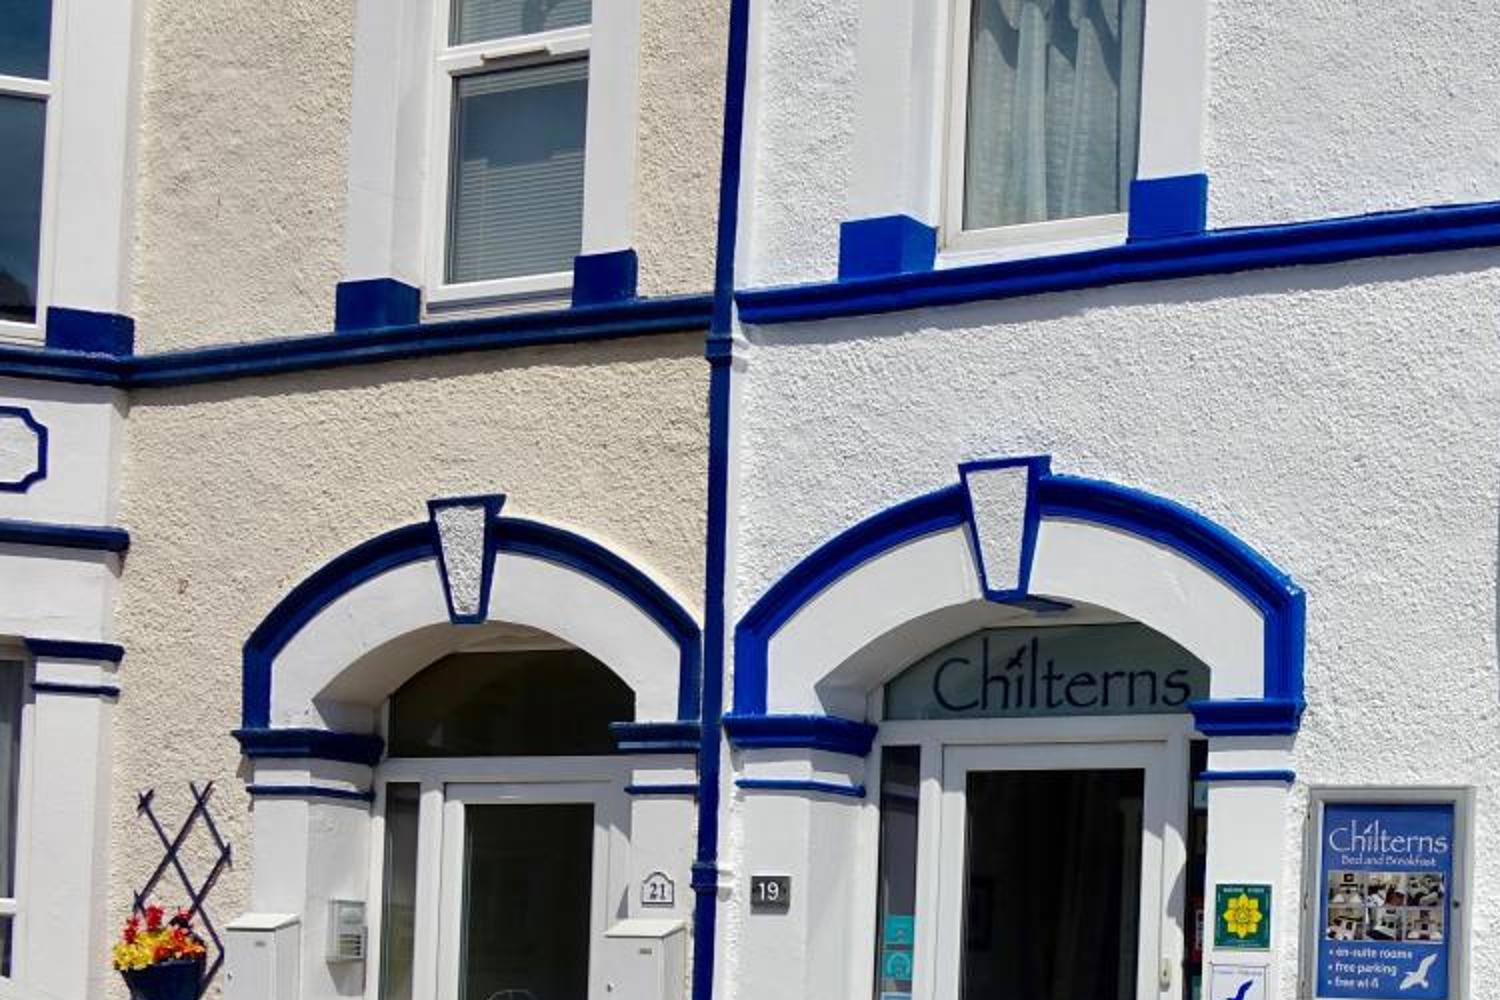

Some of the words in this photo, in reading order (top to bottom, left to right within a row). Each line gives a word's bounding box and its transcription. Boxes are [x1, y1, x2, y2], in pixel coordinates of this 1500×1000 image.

[932, 636, 1192, 713] Chilterns
[1328, 819, 1449, 853] Chilterns
[1341, 852, 1363, 865] Bed
[1385, 854, 1436, 867] Breakfast
[649, 882, 667, 901] 21
[758, 881, 779, 902] 19
[1379, 949, 1413, 960] rooms
[1335, 961, 1357, 973] free
[1357, 963, 1398, 977] parking
[1335, 976, 1355, 987] free
